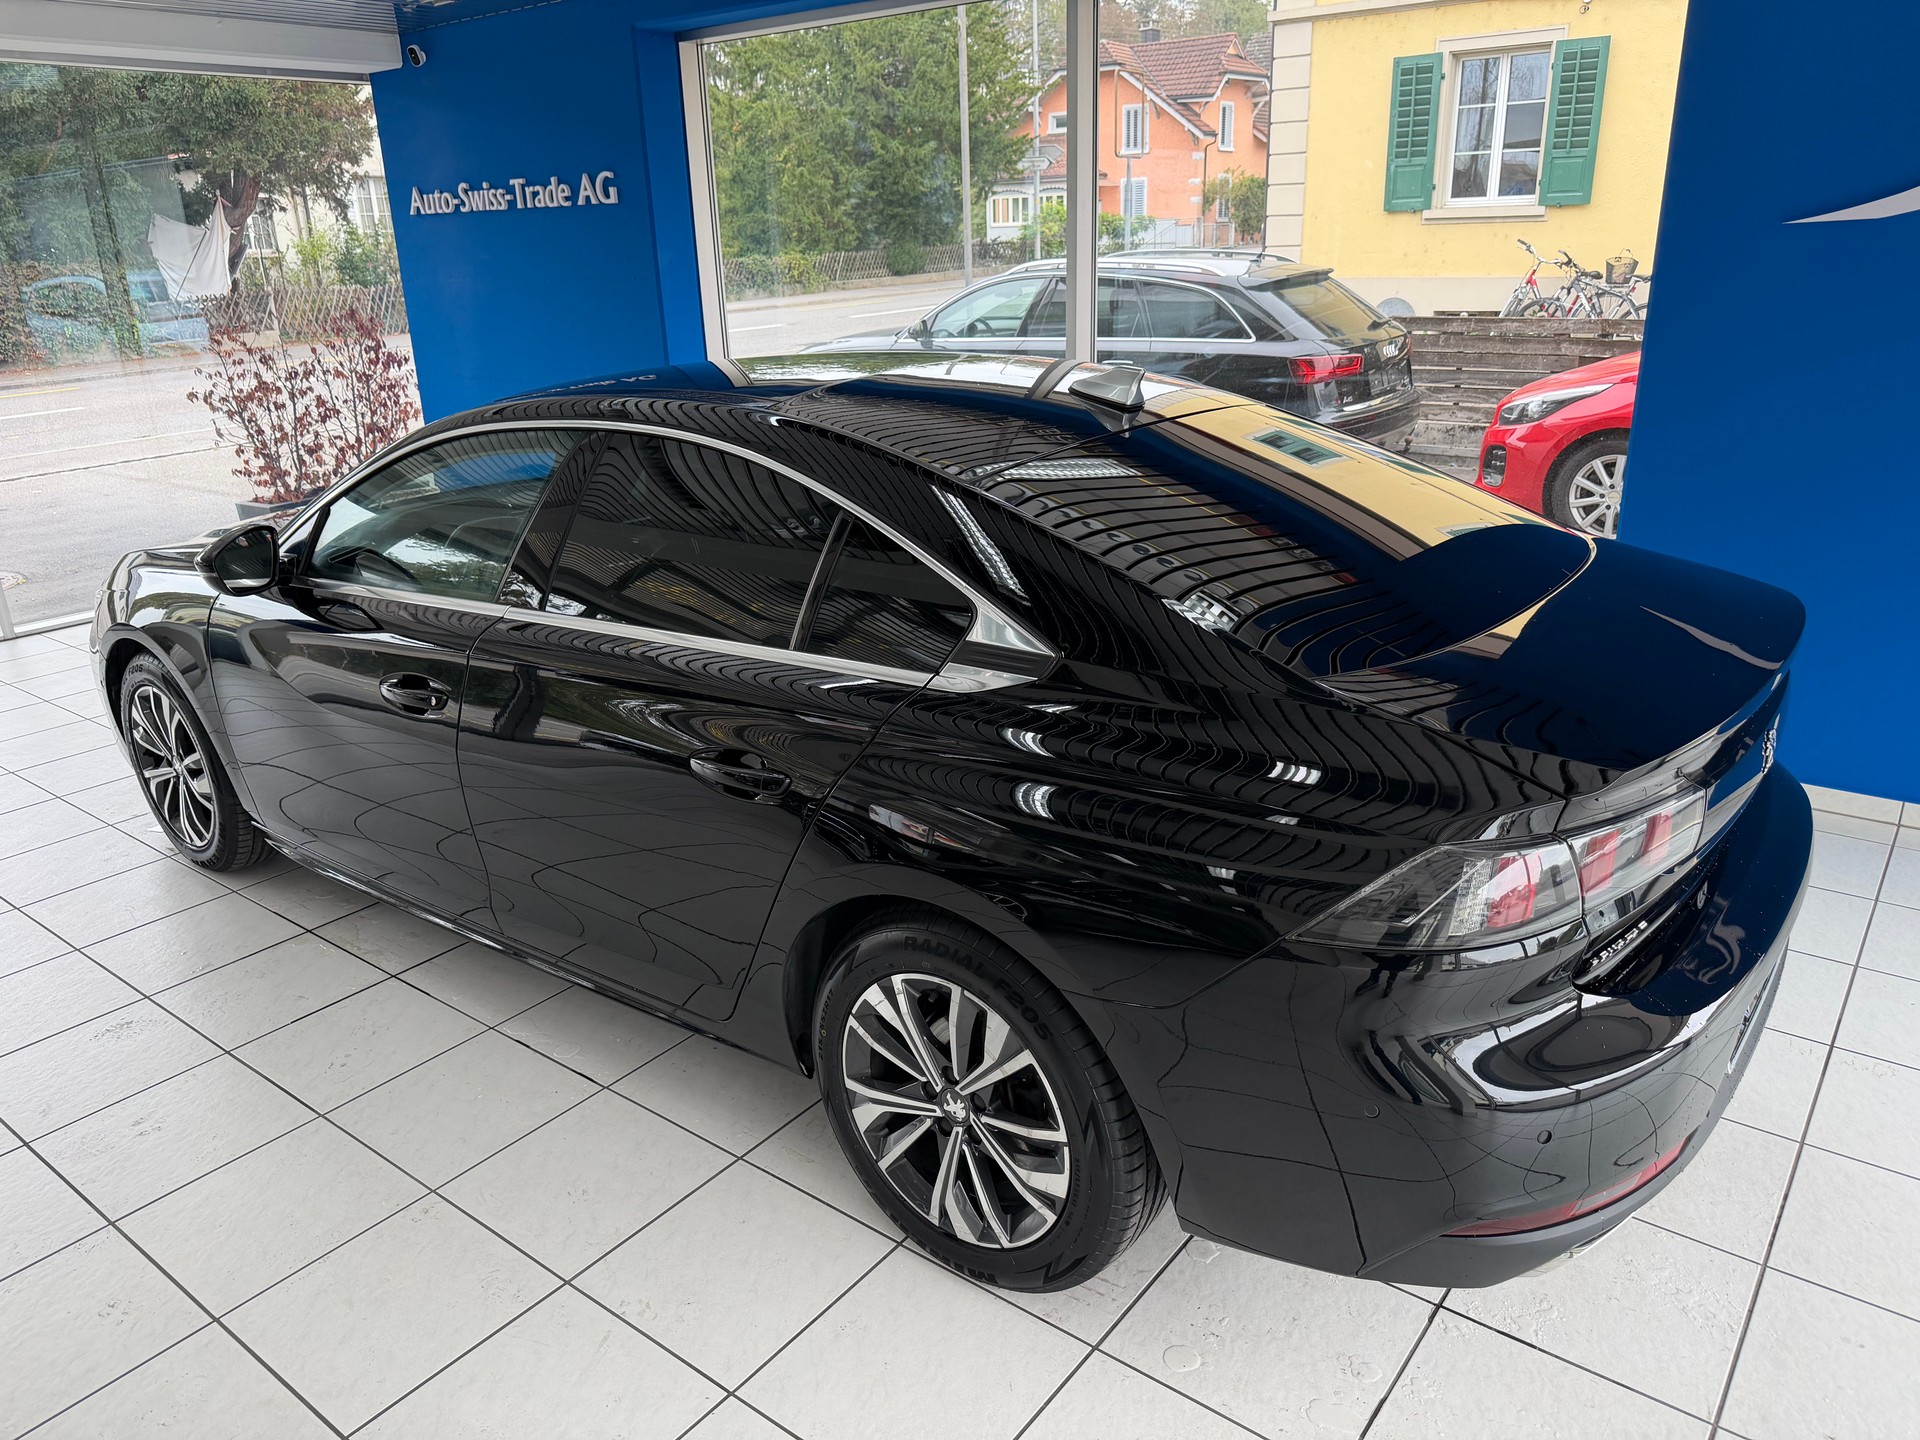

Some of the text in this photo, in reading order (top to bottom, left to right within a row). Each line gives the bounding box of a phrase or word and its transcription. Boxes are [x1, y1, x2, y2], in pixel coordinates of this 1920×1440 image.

[410, 171, 619, 215] Auto-Swiss-Trade AG
[903, 935, 1053, 1041] RADIAL F205
